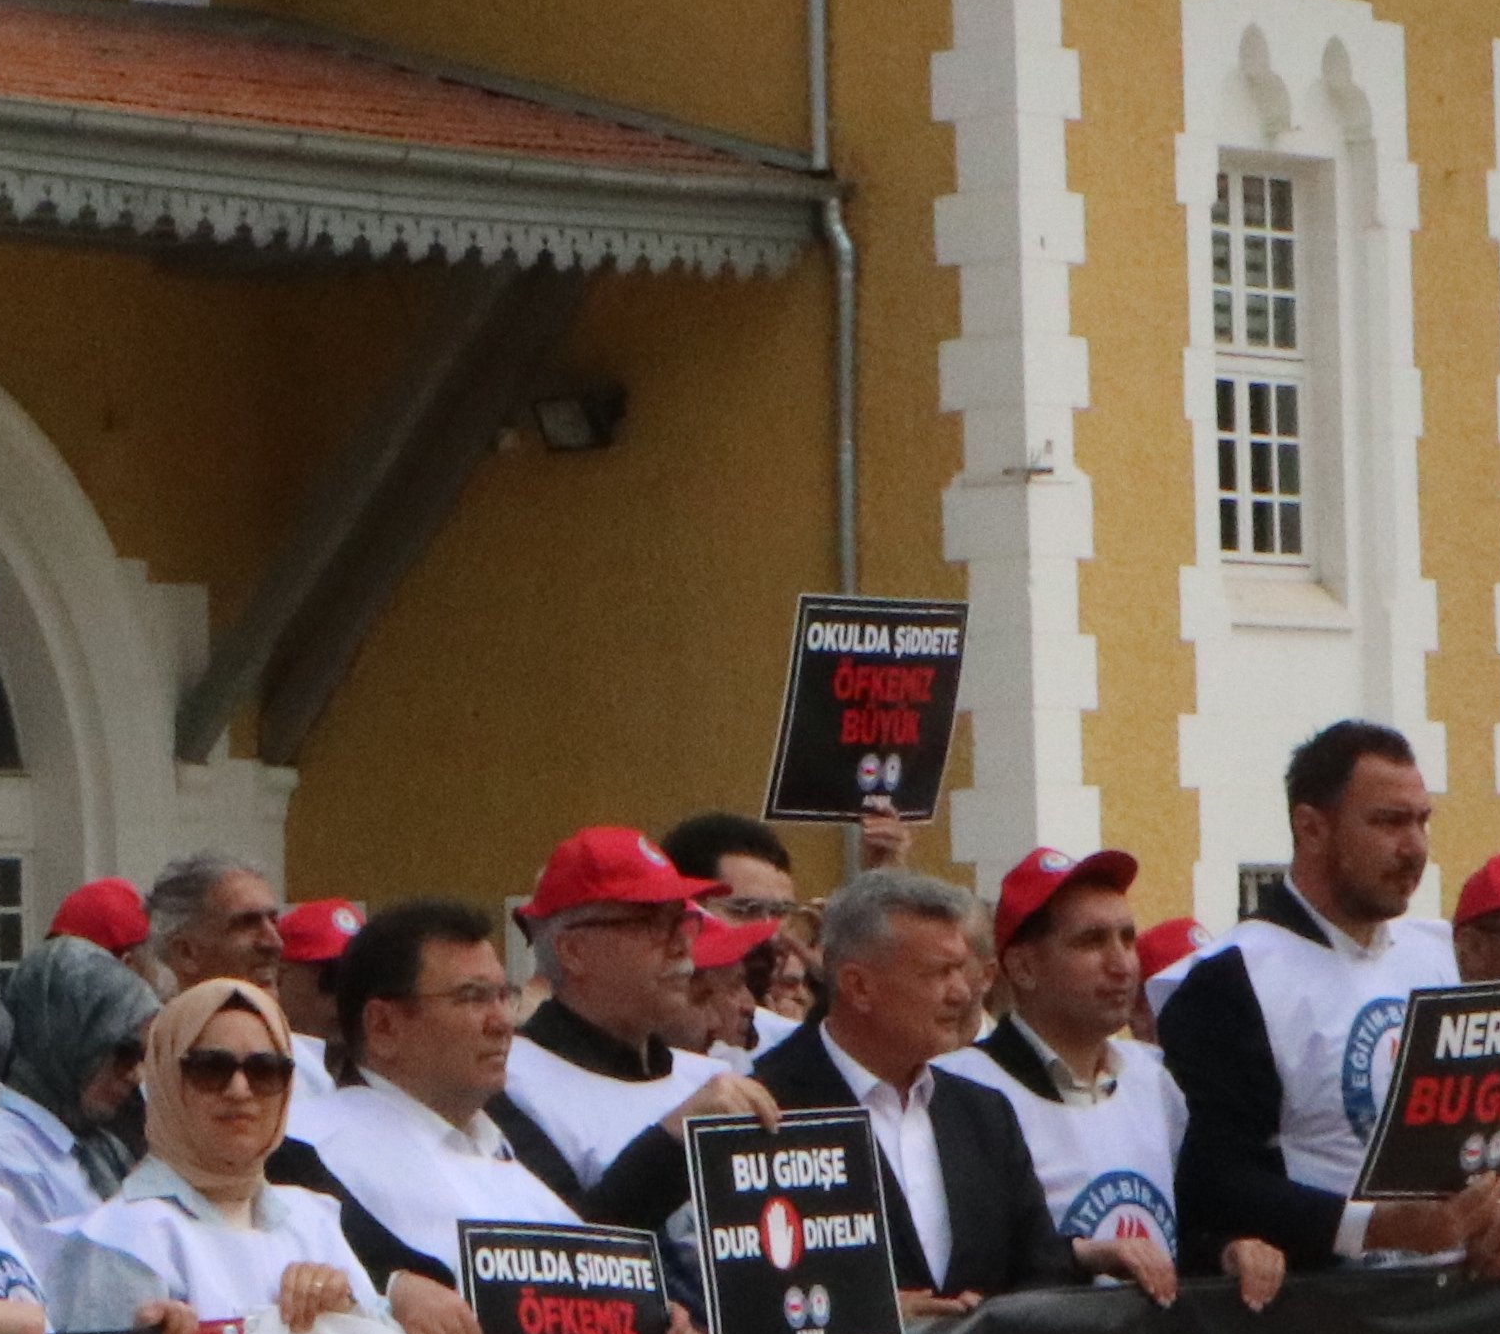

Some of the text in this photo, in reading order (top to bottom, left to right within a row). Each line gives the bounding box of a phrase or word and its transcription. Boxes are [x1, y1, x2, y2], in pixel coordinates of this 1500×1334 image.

[806, 621, 960, 659] OKULDA ŞİDDETE
[1404, 1075, 1473, 1126] BU
[731, 1147, 848, 1192] BU GİDİŞE
[713, 1213, 877, 1260] DUR DİYELİM
[474, 1247, 656, 1292] OKULDA ŞİDDETE
